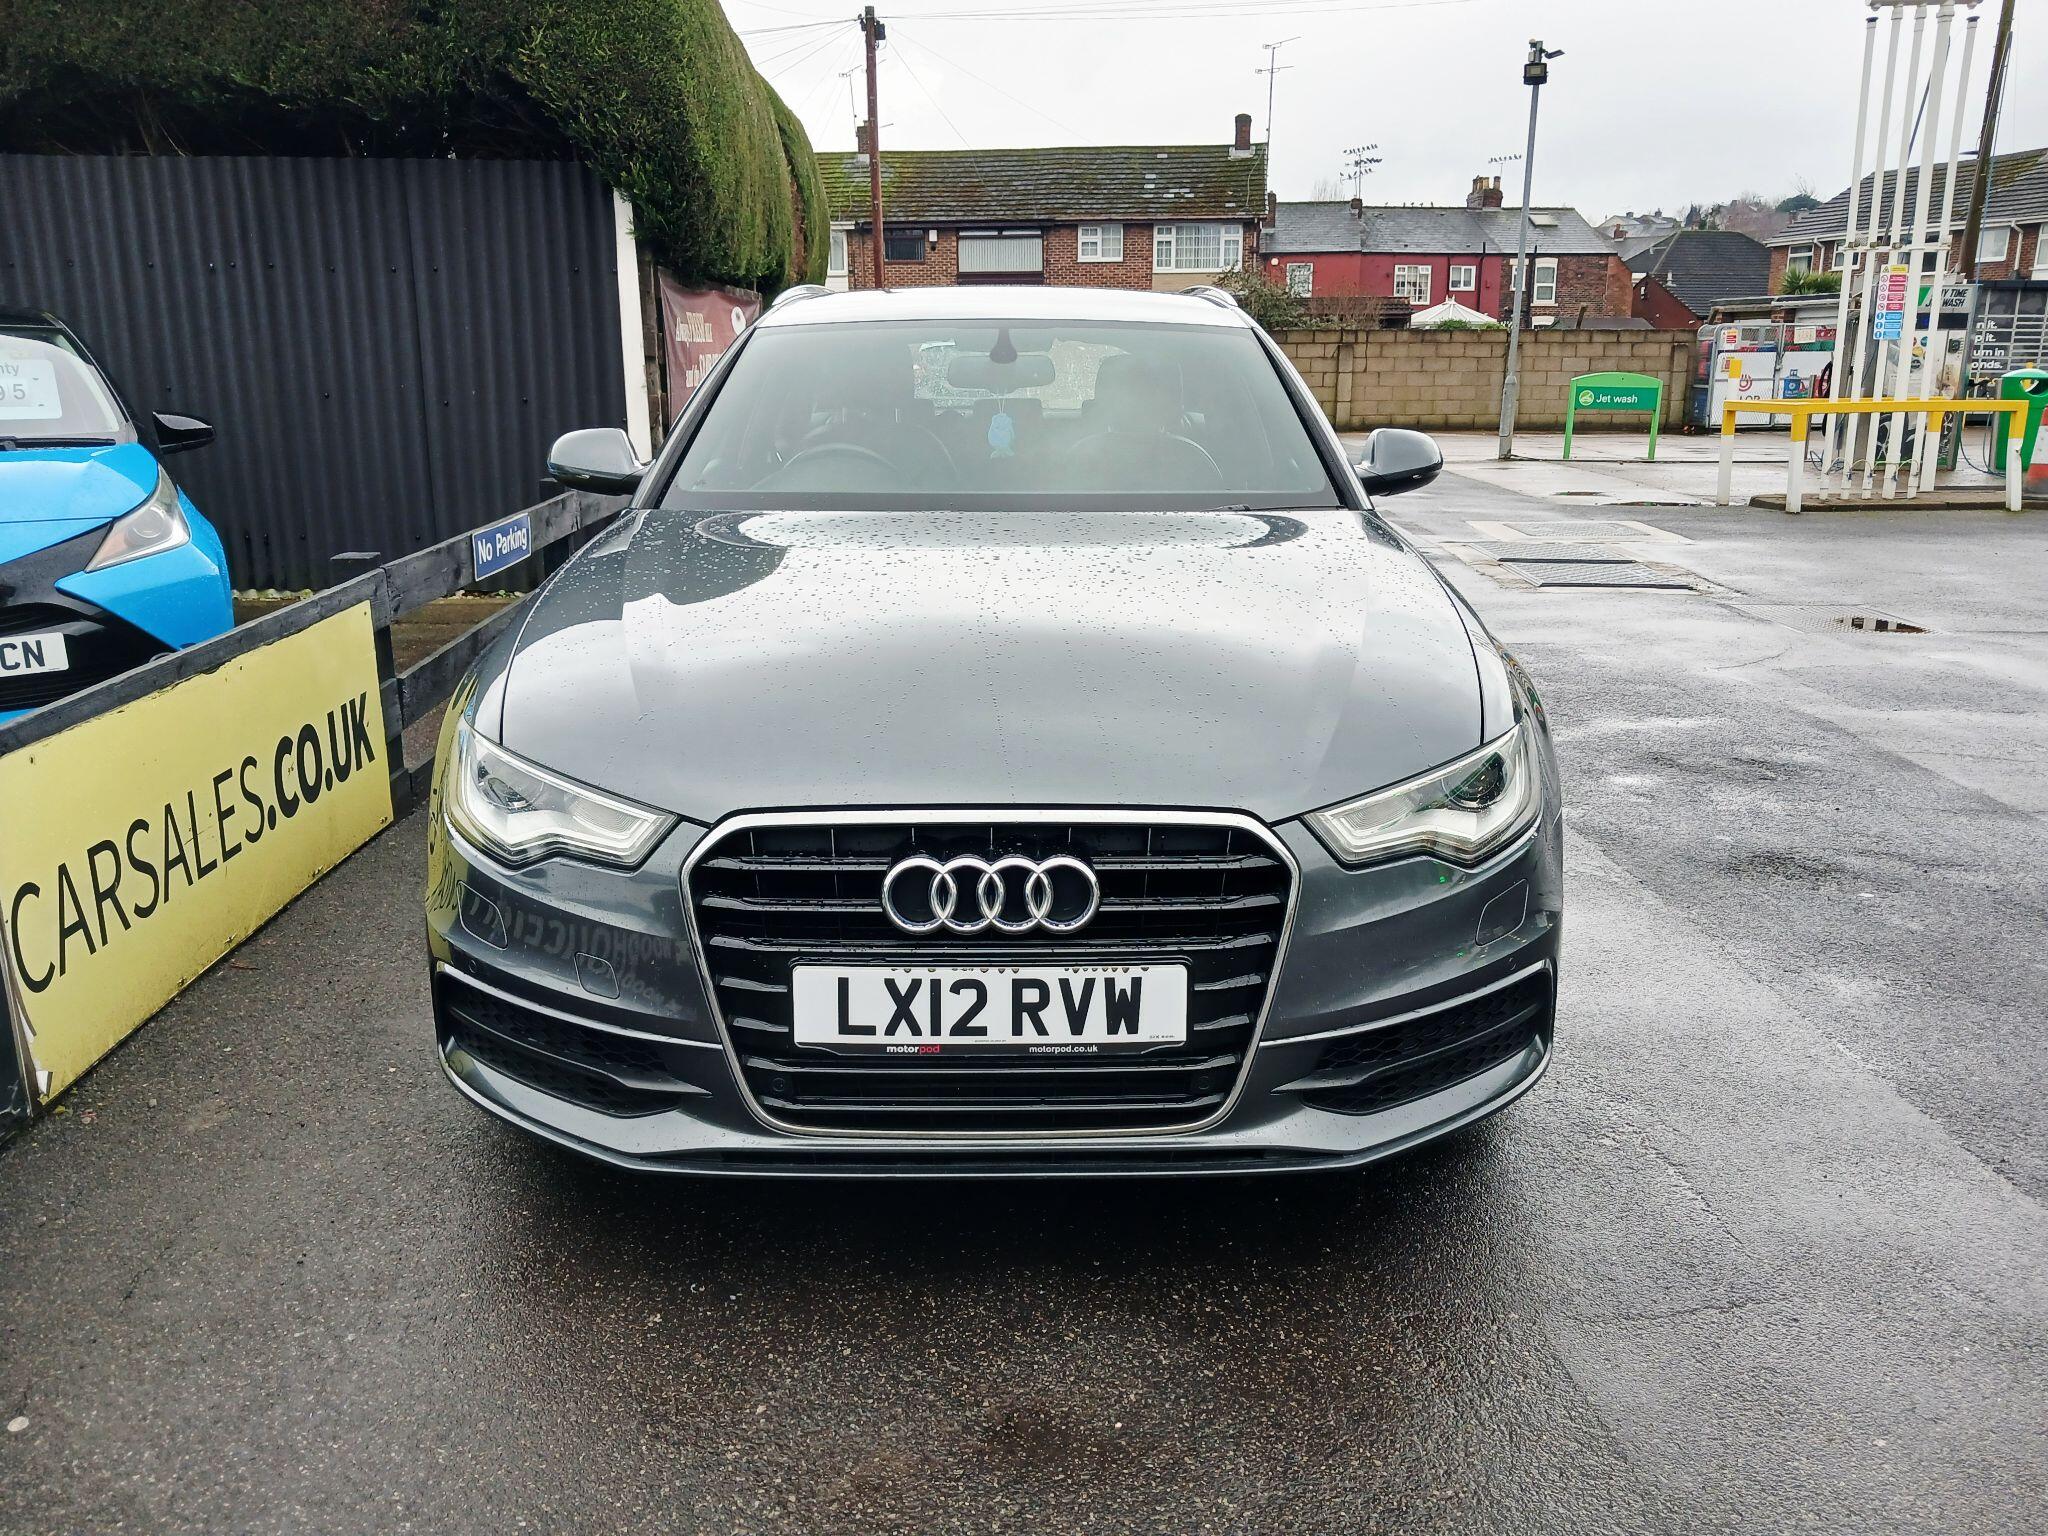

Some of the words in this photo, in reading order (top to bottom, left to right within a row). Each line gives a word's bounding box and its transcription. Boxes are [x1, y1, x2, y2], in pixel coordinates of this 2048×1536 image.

[1950, 289, 1968, 297] TIME
[1942, 299, 1965, 307] WASH
[1994, 347, 2005, 356] in
[1596, 394, 1611, 403] Jet
[1613, 394, 1638, 404] wash
[477, 539, 493, 565] No
[495, 525, 528, 557] Parking
[0, 640, 46, 671] CN
[11, 691, 376, 994] CARSALES.CO.UK
[838, 976, 989, 1037] LX12
[1011, 976, 1143, 1037] RVW
[886, 1044, 941, 1055] motorpod
[1029, 1044, 1098, 1055] motorpod.co.uk
